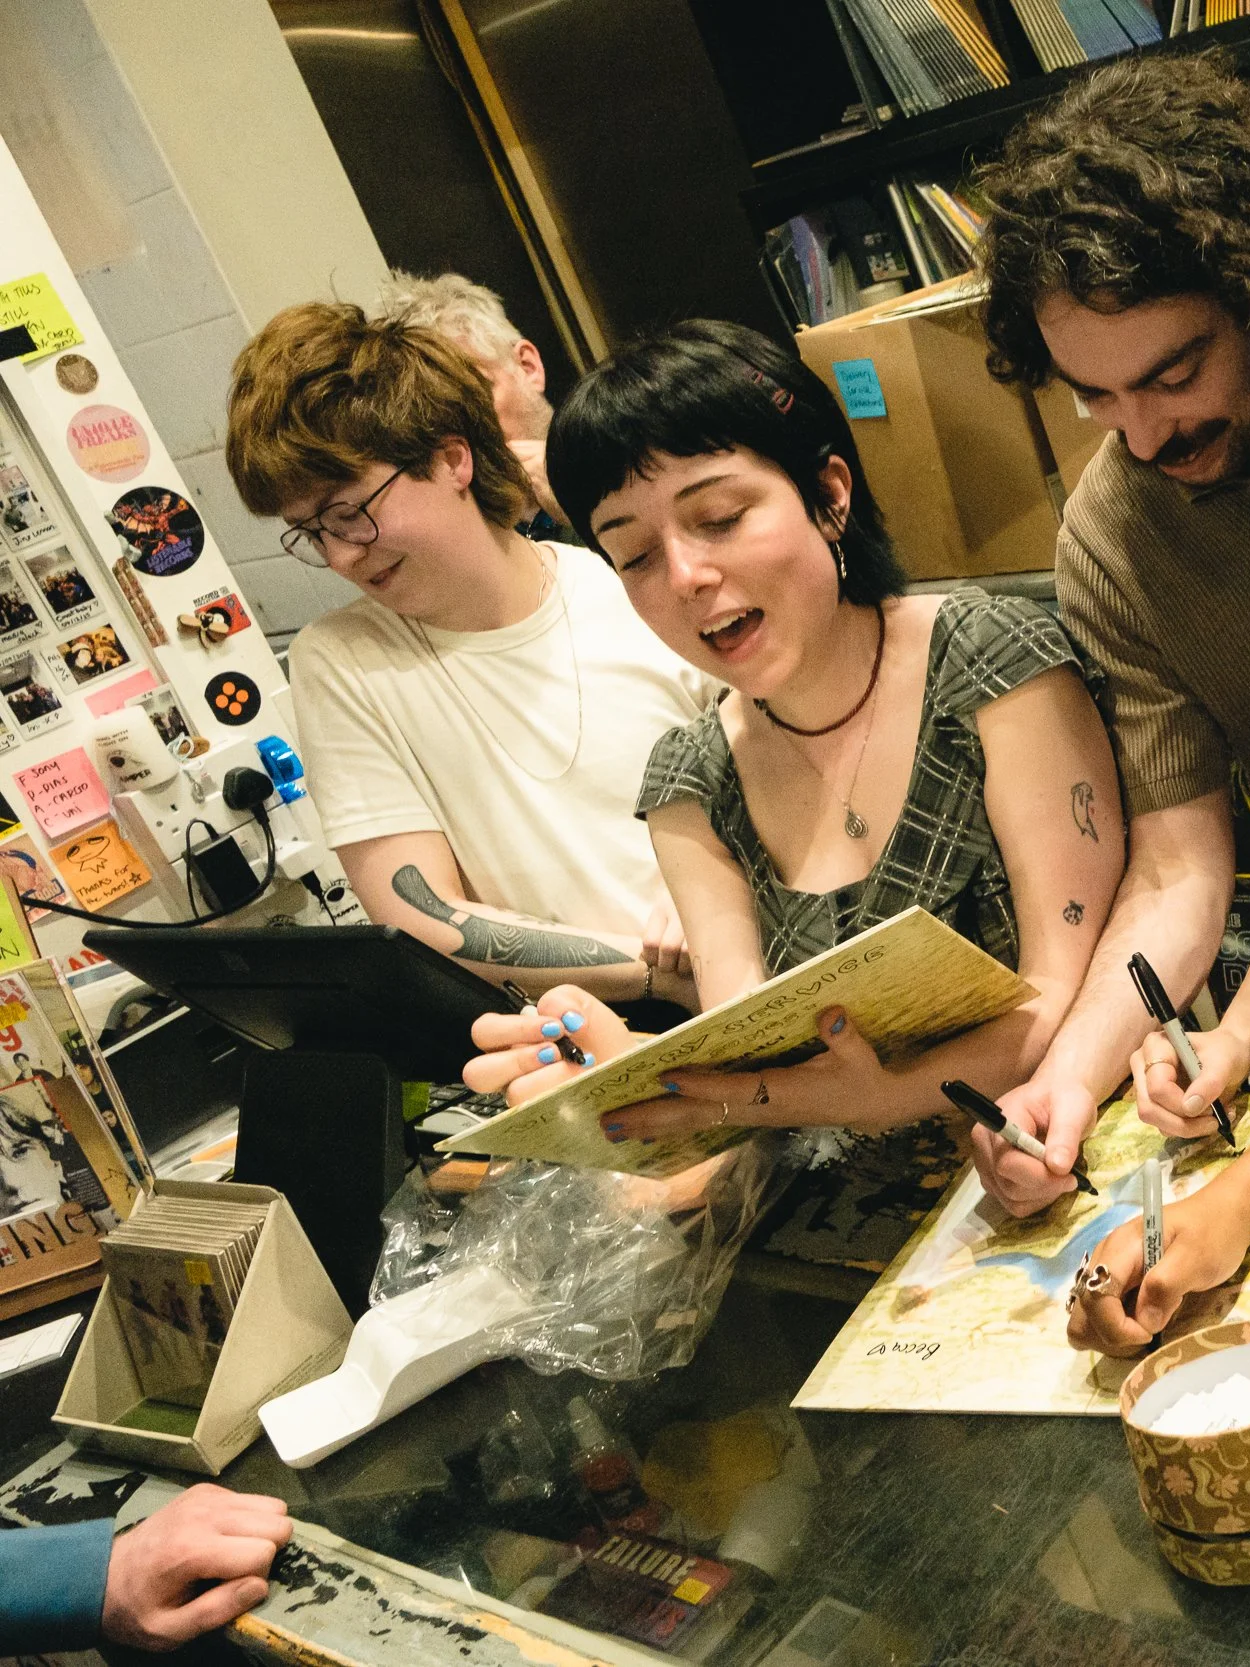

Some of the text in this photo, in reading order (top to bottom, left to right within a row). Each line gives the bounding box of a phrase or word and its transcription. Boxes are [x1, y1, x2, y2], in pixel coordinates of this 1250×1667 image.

[146, 536, 193, 567] LISTENABLE
[152, 548, 194, 574] RECORDS
[31, 760, 61, 779] Sony
[76, 877, 112, 898] Thanks
[114, 864, 129, 877] for
[722, 945, 885, 1035] SERVICE
[892, 1342, 941, 1360] Becca
[593, 1536, 697, 1586] FAILURE
